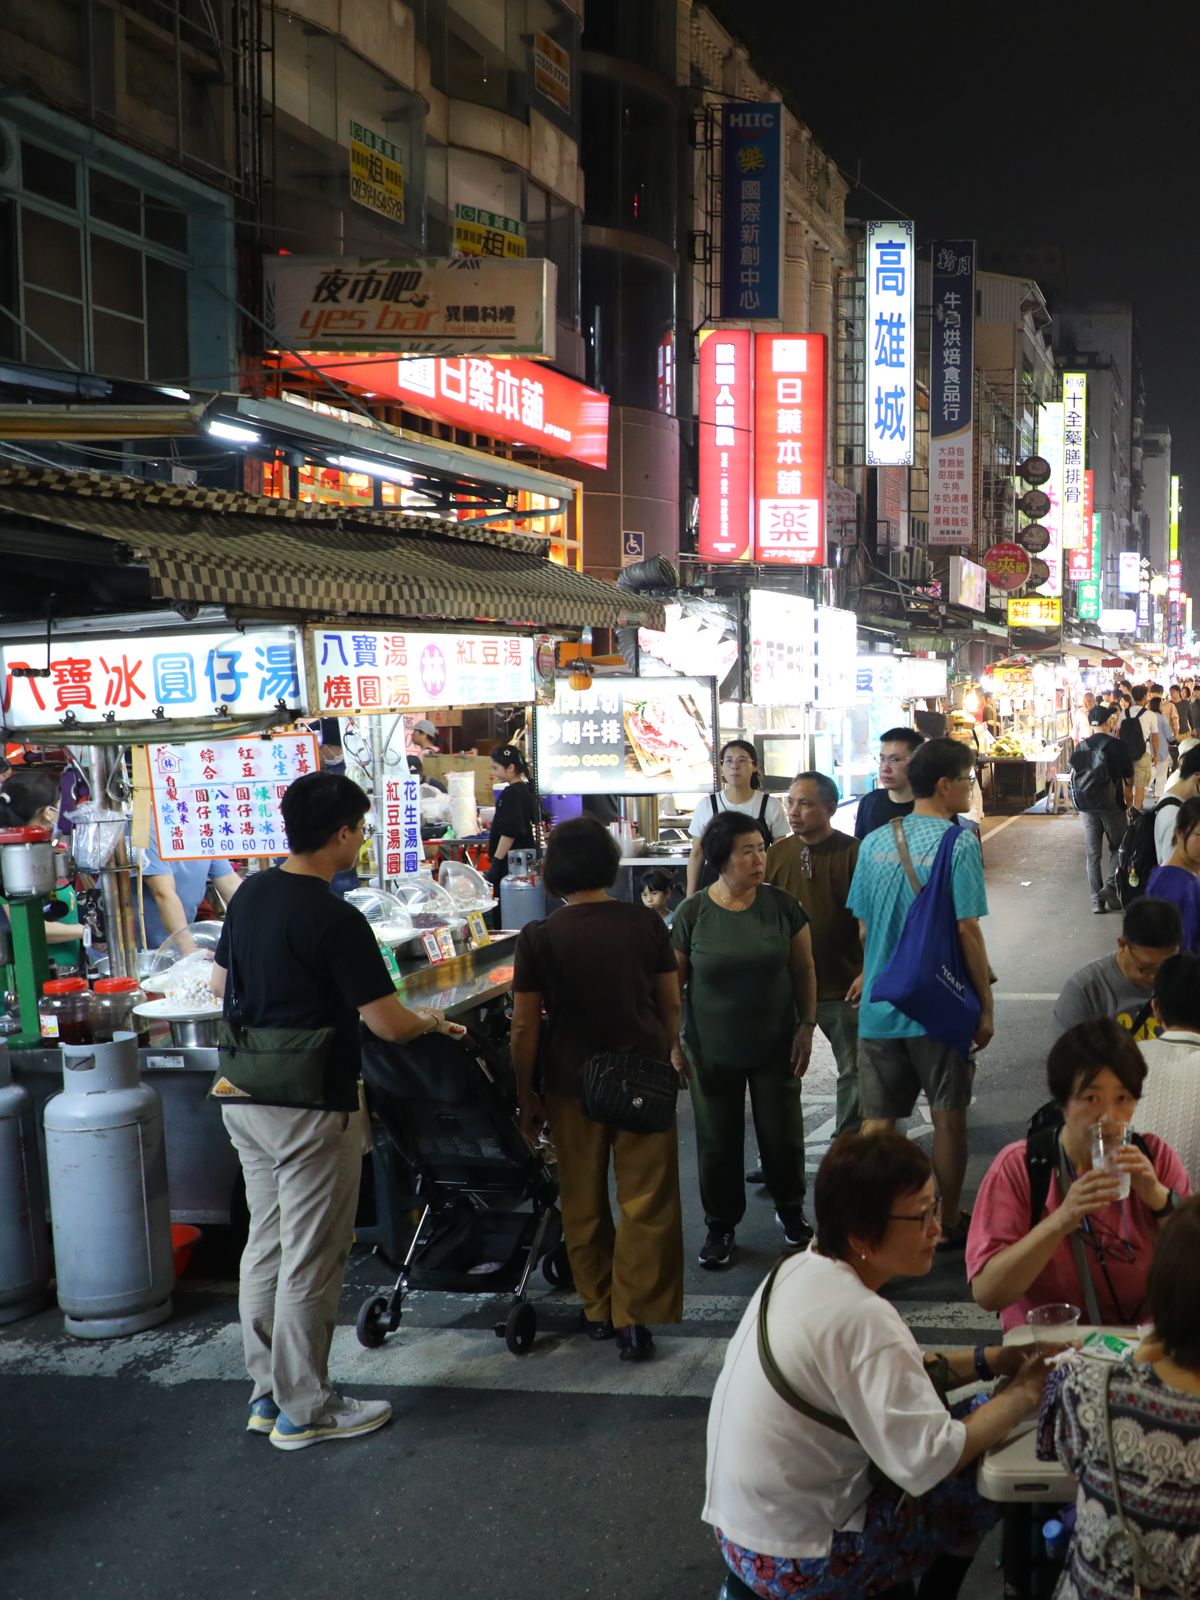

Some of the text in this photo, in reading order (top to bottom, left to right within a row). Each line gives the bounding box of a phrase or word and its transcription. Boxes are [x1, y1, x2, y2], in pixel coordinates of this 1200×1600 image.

[730, 113, 774, 127] HIIC
[368, 154, 384, 185] 租
[481, 229, 505, 258] 租
[740, 180, 761, 310] 國際新創中心
[936, 248, 970, 276] 新月
[312, 269, 423, 304] 夜市吧
[295, 304, 441, 339] yes bar
[874, 239, 906, 442] 高雄城
[943, 292, 961, 421] 牛角烘焙食品行
[1065, 392, 1083, 503] 十全藥膳排骨
[321, 634, 522, 668] 八寶湯 紅豆湯
[4, 645, 299, 712] 八寶冰圓仔湯
[324, 675, 523, 709] 燒圓湯 花生湯
[200, 743, 312, 780] 綜合 紅豆 花生 草莓
[166, 776, 178, 801] 自製
[195, 789, 214, 837] 圓仔湯
[214, 789, 234, 836] 八寶冰
[236, 787, 255, 836] 圓仔湯
[386, 781, 400, 874] 紅豆湯圓
[404, 780, 417, 873] 花生湯圓
[171, 826, 184, 850] 湯圓
[201, 838, 214, 849] 60
[221, 840, 234, 850] 60
[242, 839, 256, 850] 60
[261, 839, 275, 850] 70
